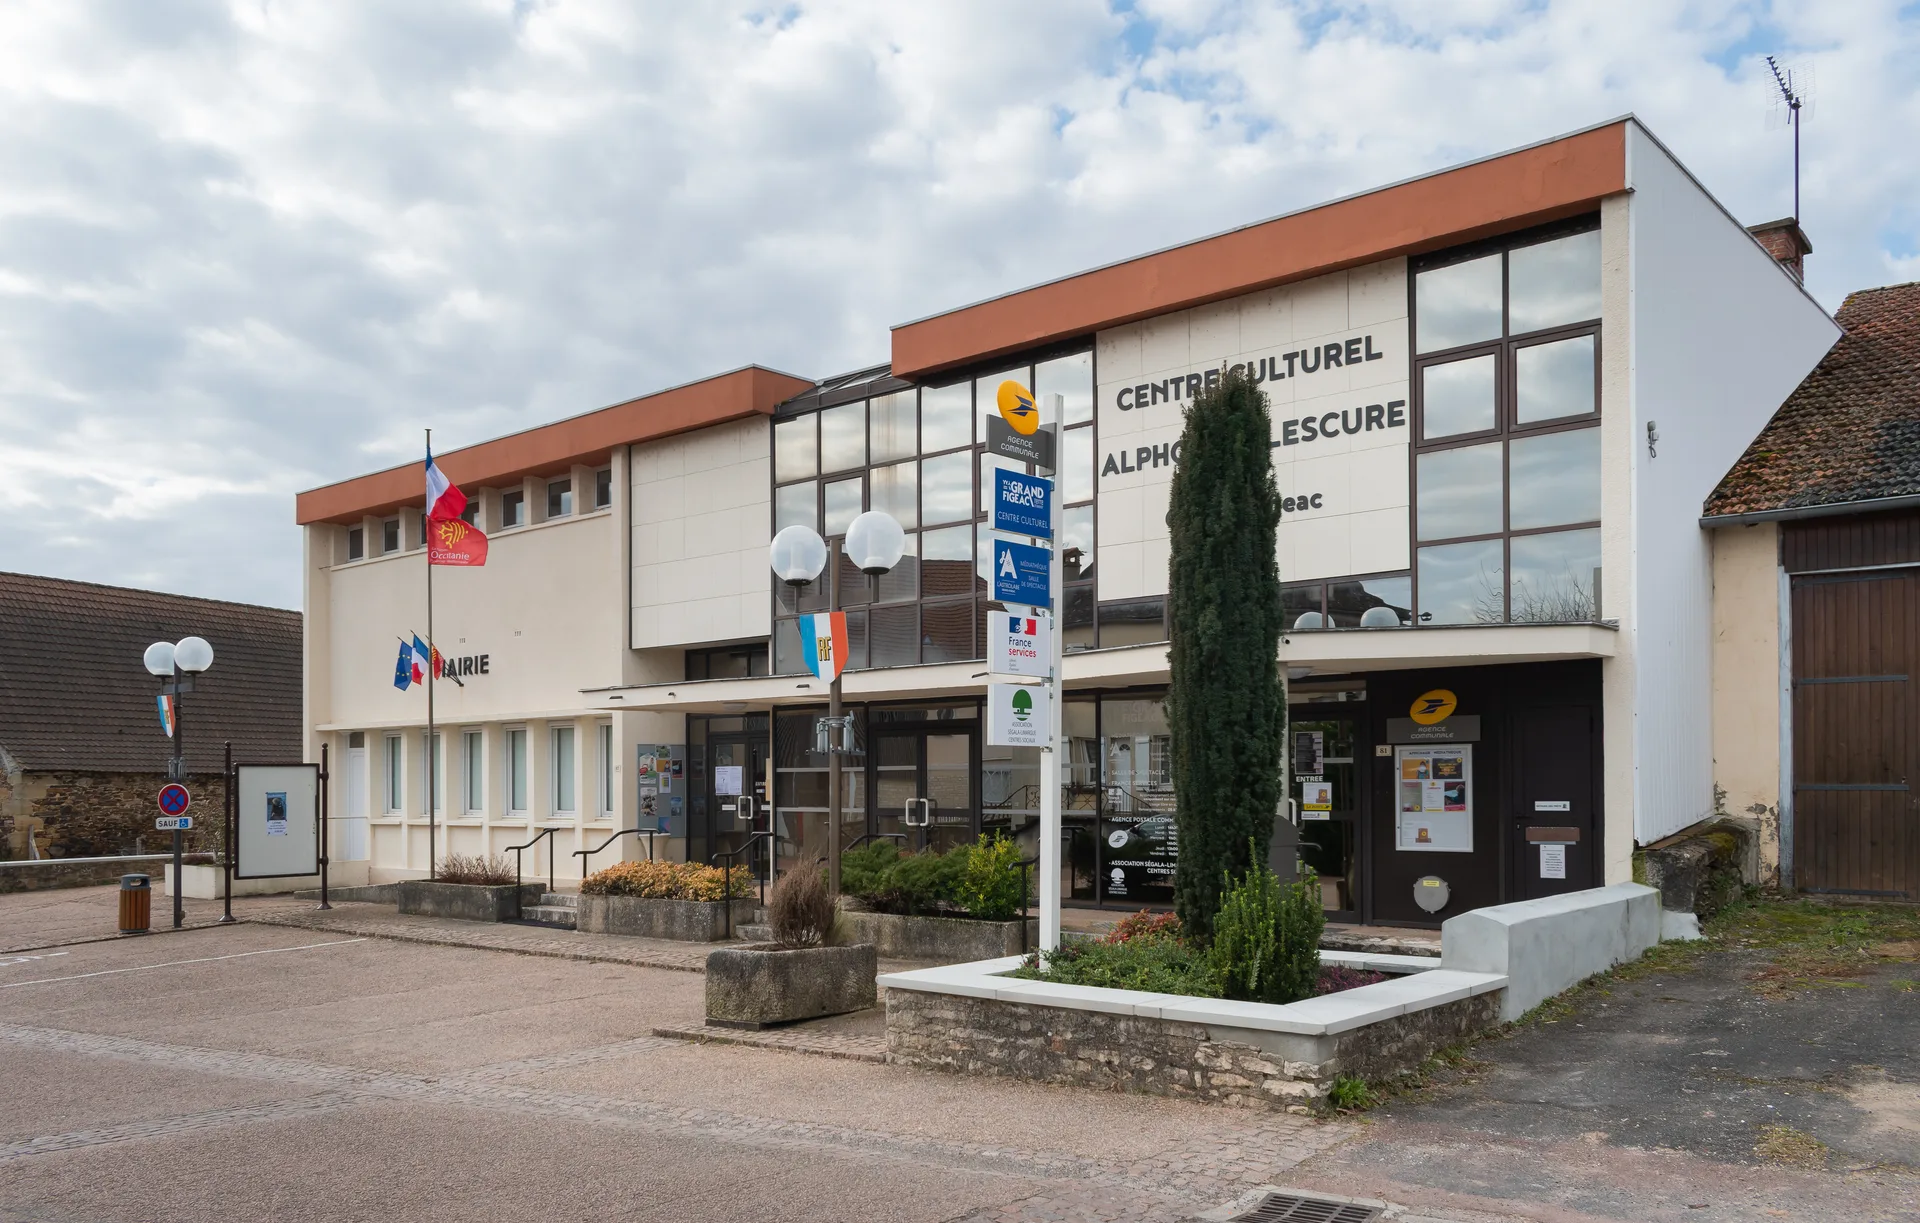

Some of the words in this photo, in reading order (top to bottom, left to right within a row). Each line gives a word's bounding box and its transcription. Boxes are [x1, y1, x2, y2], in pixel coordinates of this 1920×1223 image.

[1116, 368, 1221, 412] CENTRE
[1007, 435, 1033, 449] AGENCE
[1000, 443, 1039, 459] COMMUNALE
[1002, 490, 1031, 506] FIGEAC
[1010, 481, 1044, 503] GRAND
[997, 511, 1020, 523] CENTRE
[1020, 516, 1048, 529] CULTUREL
[430, 550, 470, 560] Occitanie
[1008, 636, 1032, 647] France
[1008, 647, 1037, 658] services
[158, 815, 178, 827] SAUF
